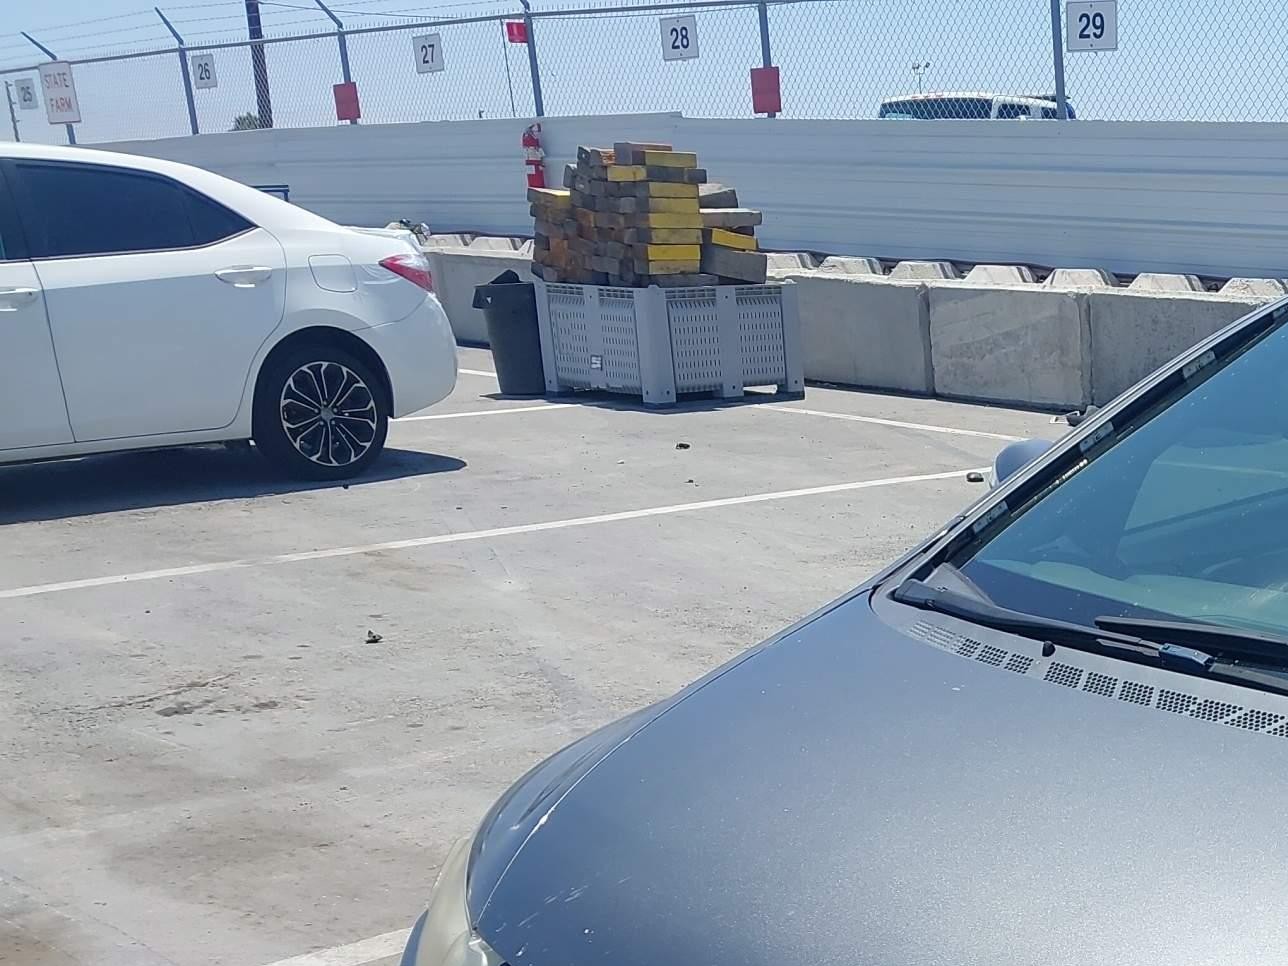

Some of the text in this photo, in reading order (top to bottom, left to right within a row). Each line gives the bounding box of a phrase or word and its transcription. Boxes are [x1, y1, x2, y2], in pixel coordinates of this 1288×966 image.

[1078, 13, 1105, 39] 29
[669, 26, 690, 50] 28
[420, 44, 436, 64] 27
[197, 62, 212, 80] 26
[44, 73, 70, 89] STATE
[20, 86, 33, 103] 25
[49, 96, 73, 113] FARM
